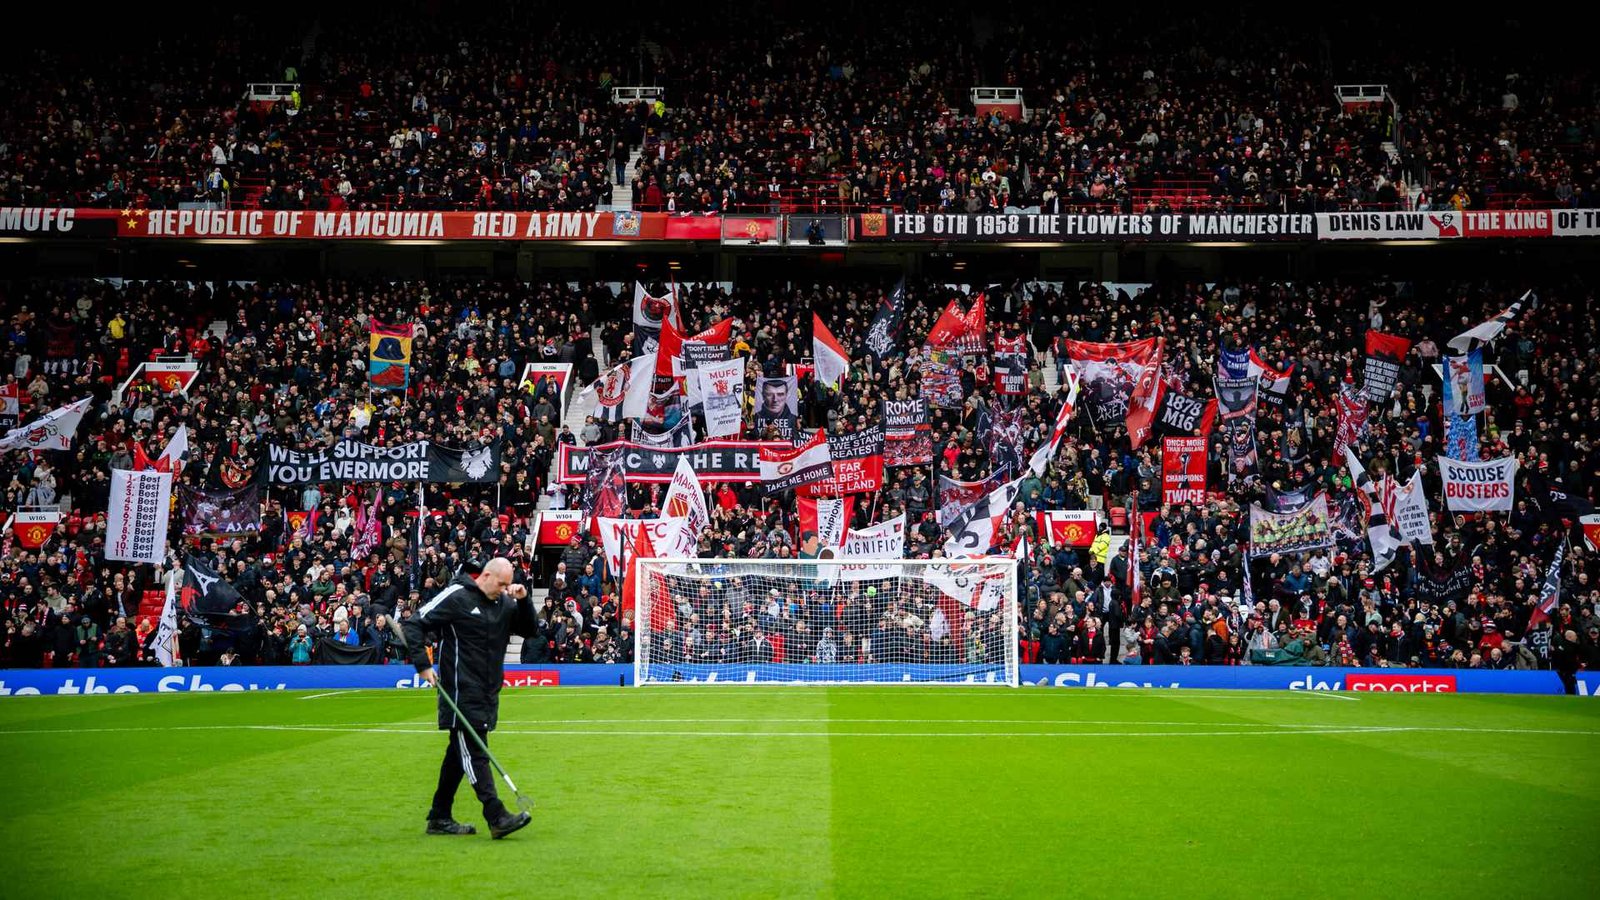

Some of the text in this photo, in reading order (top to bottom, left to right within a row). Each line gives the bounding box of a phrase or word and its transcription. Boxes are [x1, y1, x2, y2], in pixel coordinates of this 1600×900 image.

[0, 207, 75, 231] MUFC
[274, 211, 302, 236] OF
[894, 213, 1313, 235] FEB 6TH 1958 THE FLOWERS OF MANCHESTER
[1329, 214, 1424, 231] DENIS LAW
[1466, 212, 1500, 230] THE
[1505, 211, 1547, 230] KING
[1558, 211, 1579, 229] OF
[709, 369, 738, 379] MUFC
[885, 399, 924, 416] ROME
[1167, 391, 1203, 417] 1878
[774, 418, 789, 428] SEE
[886, 413, 925, 426] MANDALAY
[1161, 407, 1195, 432] M16
[839, 434, 857, 442] WE
[858, 424, 880, 438] ARE
[833, 442, 852, 451] WE
[853, 432, 885, 446] STAND
[1166, 439, 1185, 447] ONCE
[269, 440, 429, 465] WE'LL SUPPORT
[831, 443, 878, 459] REATEST
[269, 461, 429, 483] YOU EVERMORE
[840, 461, 861, 472] FAR
[140, 474, 160, 483] Best
[766, 467, 829, 493] TAKE ME HOME
[839, 470, 866, 482] BEST
[1165, 474, 1204, 483] CHAMPIONS
[1448, 466, 1505, 482] SCOUSE
[139, 482, 159, 490] Best
[810, 480, 876, 494] IN THE LAND
[1447, 482, 1509, 499] BUSTERS
[138, 490, 158, 498] Best
[1164, 490, 1205, 503] TWICE
[138, 498, 158, 506] Best
[137, 505, 158, 513] Best
[136, 520, 156, 528] Best
[134, 528, 154, 536] Best
[613, 522, 668, 541] MUFC
[133, 542, 153, 551] Best
[134, 536, 154, 544] Best
[132, 550, 152, 559] Best
